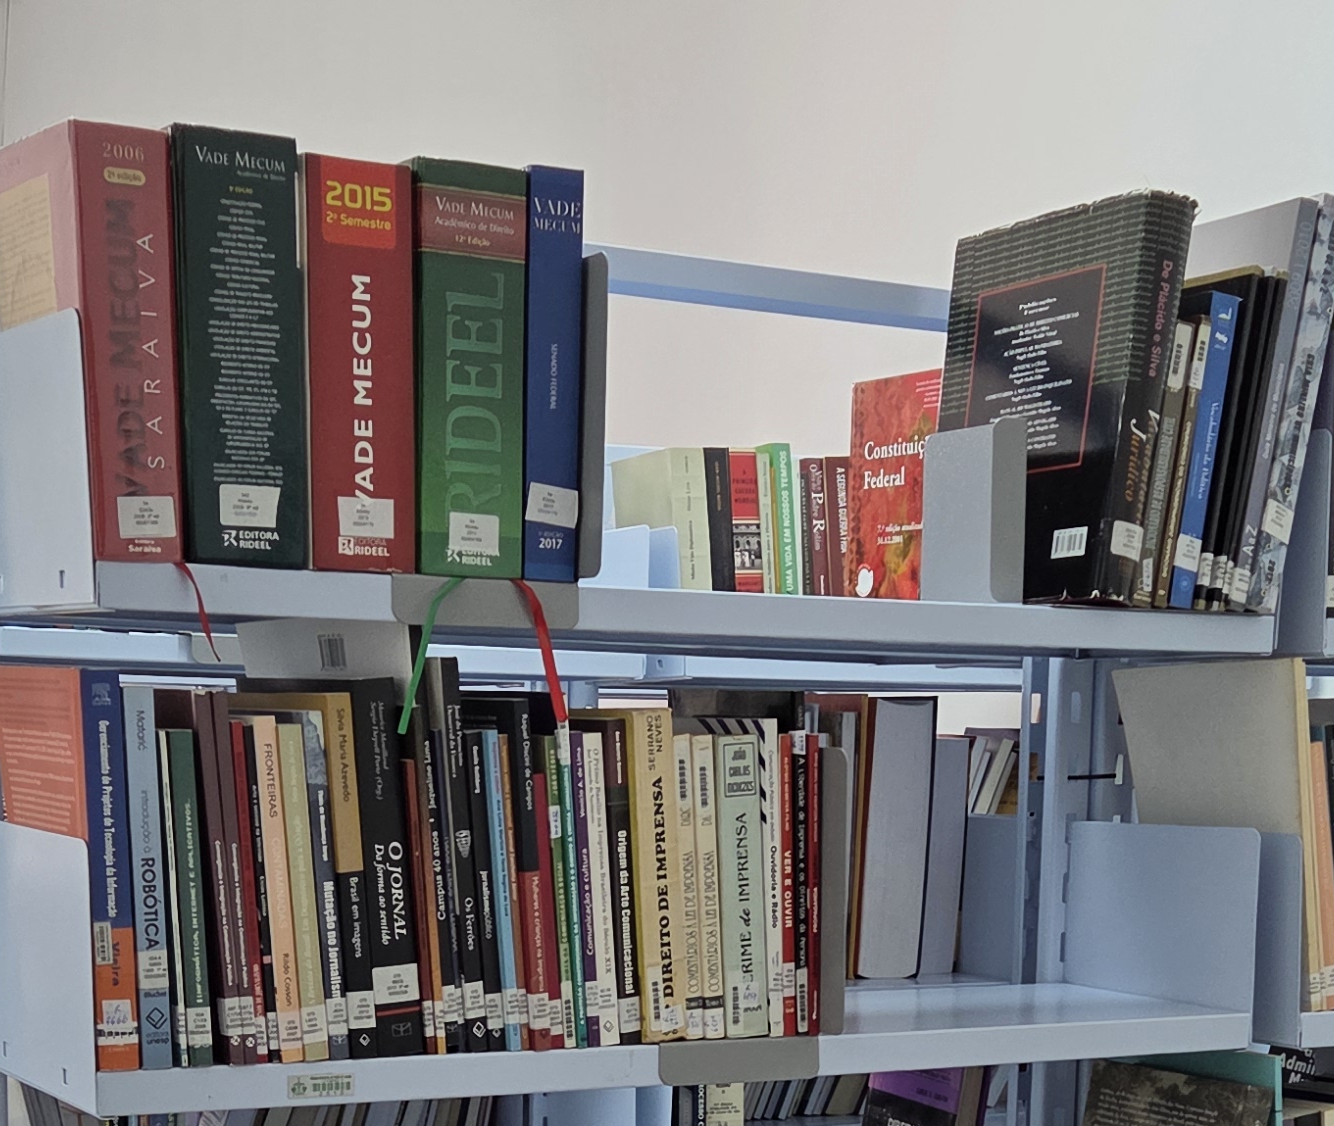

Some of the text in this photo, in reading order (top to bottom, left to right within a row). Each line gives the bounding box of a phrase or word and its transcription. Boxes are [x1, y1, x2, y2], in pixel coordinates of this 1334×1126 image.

[102, 142, 145, 162] 2006
[325, 180, 392, 212] 2015
[435, 196, 514, 221] VADE MECUM
[533, 197, 582, 219] VADE
[533, 216, 581, 234] MECUM
[1161, 259, 1174, 279] De
[1155, 282, 1171, 331] Plácido
[136, 234, 165, 468] SARAIVA
[1149, 344, 1162, 377] Silva
[351, 274, 374, 509] VADE MECUM
[863, 465, 905, 490] Federal
[539, 538, 563, 550] 2017
[779, 450, 795, 592] UMA VIDA EM NOSSOS TEMPOS
[355, 545, 390, 557] RIDEEL
[647, 714, 656, 771] SERRANO
[264, 743, 278, 819] FRONTEIRAS
[386, 841, 407, 940] O JORNAL
[432, 830, 447, 921] Campus 40 anos
[651, 775, 675, 996] DIREITO DE IMPRENSA
[784, 850, 792, 929] VER E OUVIR
[141, 857, 161, 951] ROBÓTICA
